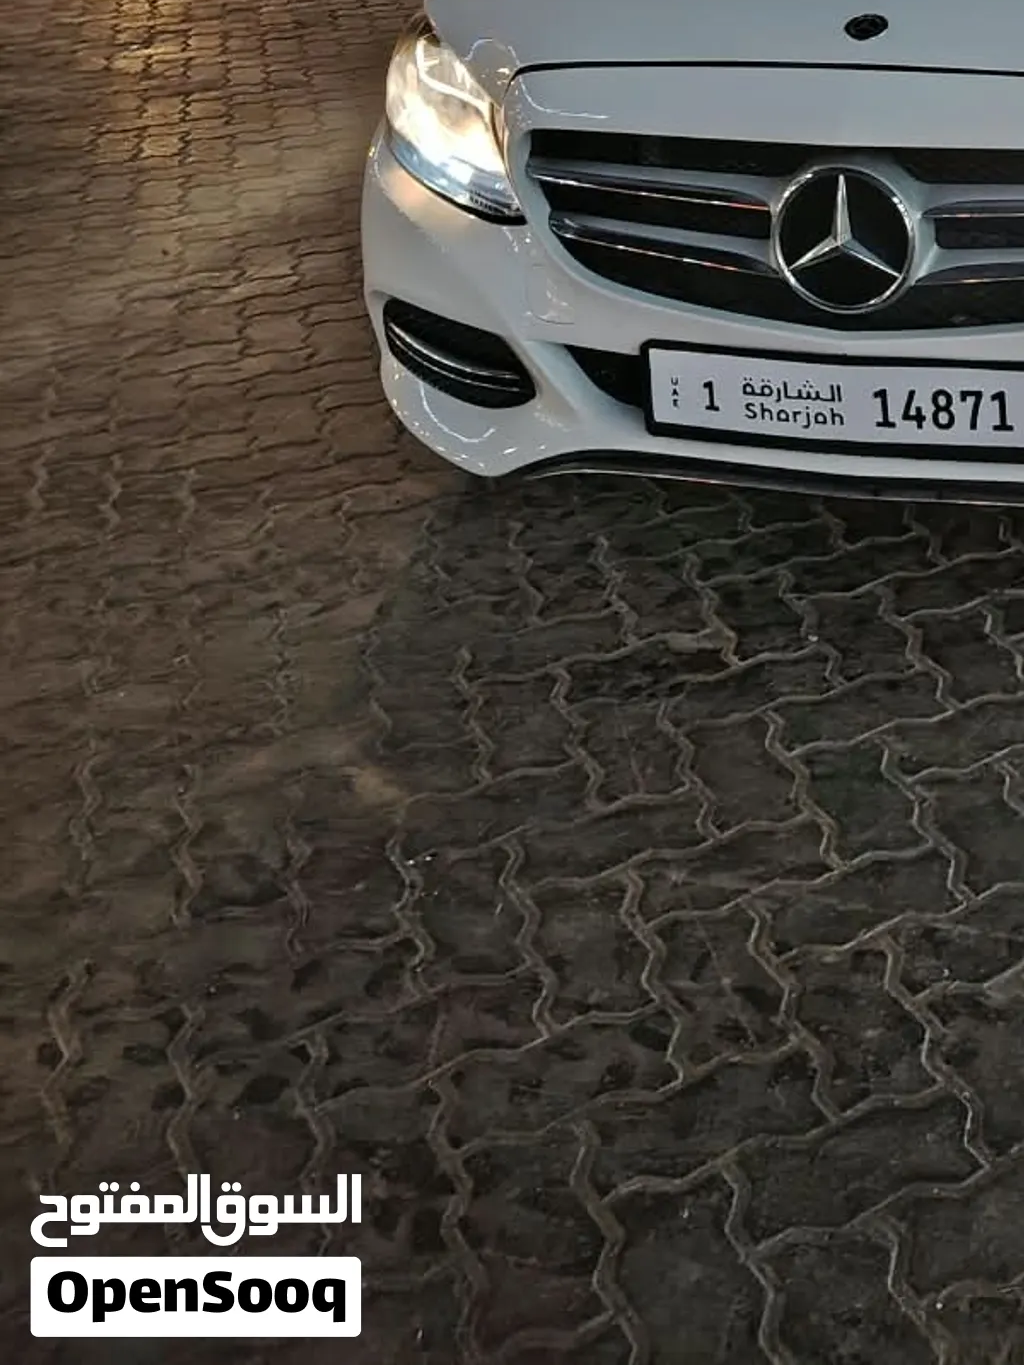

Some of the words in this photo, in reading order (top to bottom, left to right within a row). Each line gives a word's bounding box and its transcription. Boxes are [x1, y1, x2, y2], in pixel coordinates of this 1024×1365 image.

[703, 380, 720, 412] 1
[742, 376, 842, 402] الشارقة
[744, 402, 844, 428] Sharjah
[872, 387, 1015, 431] 14871
